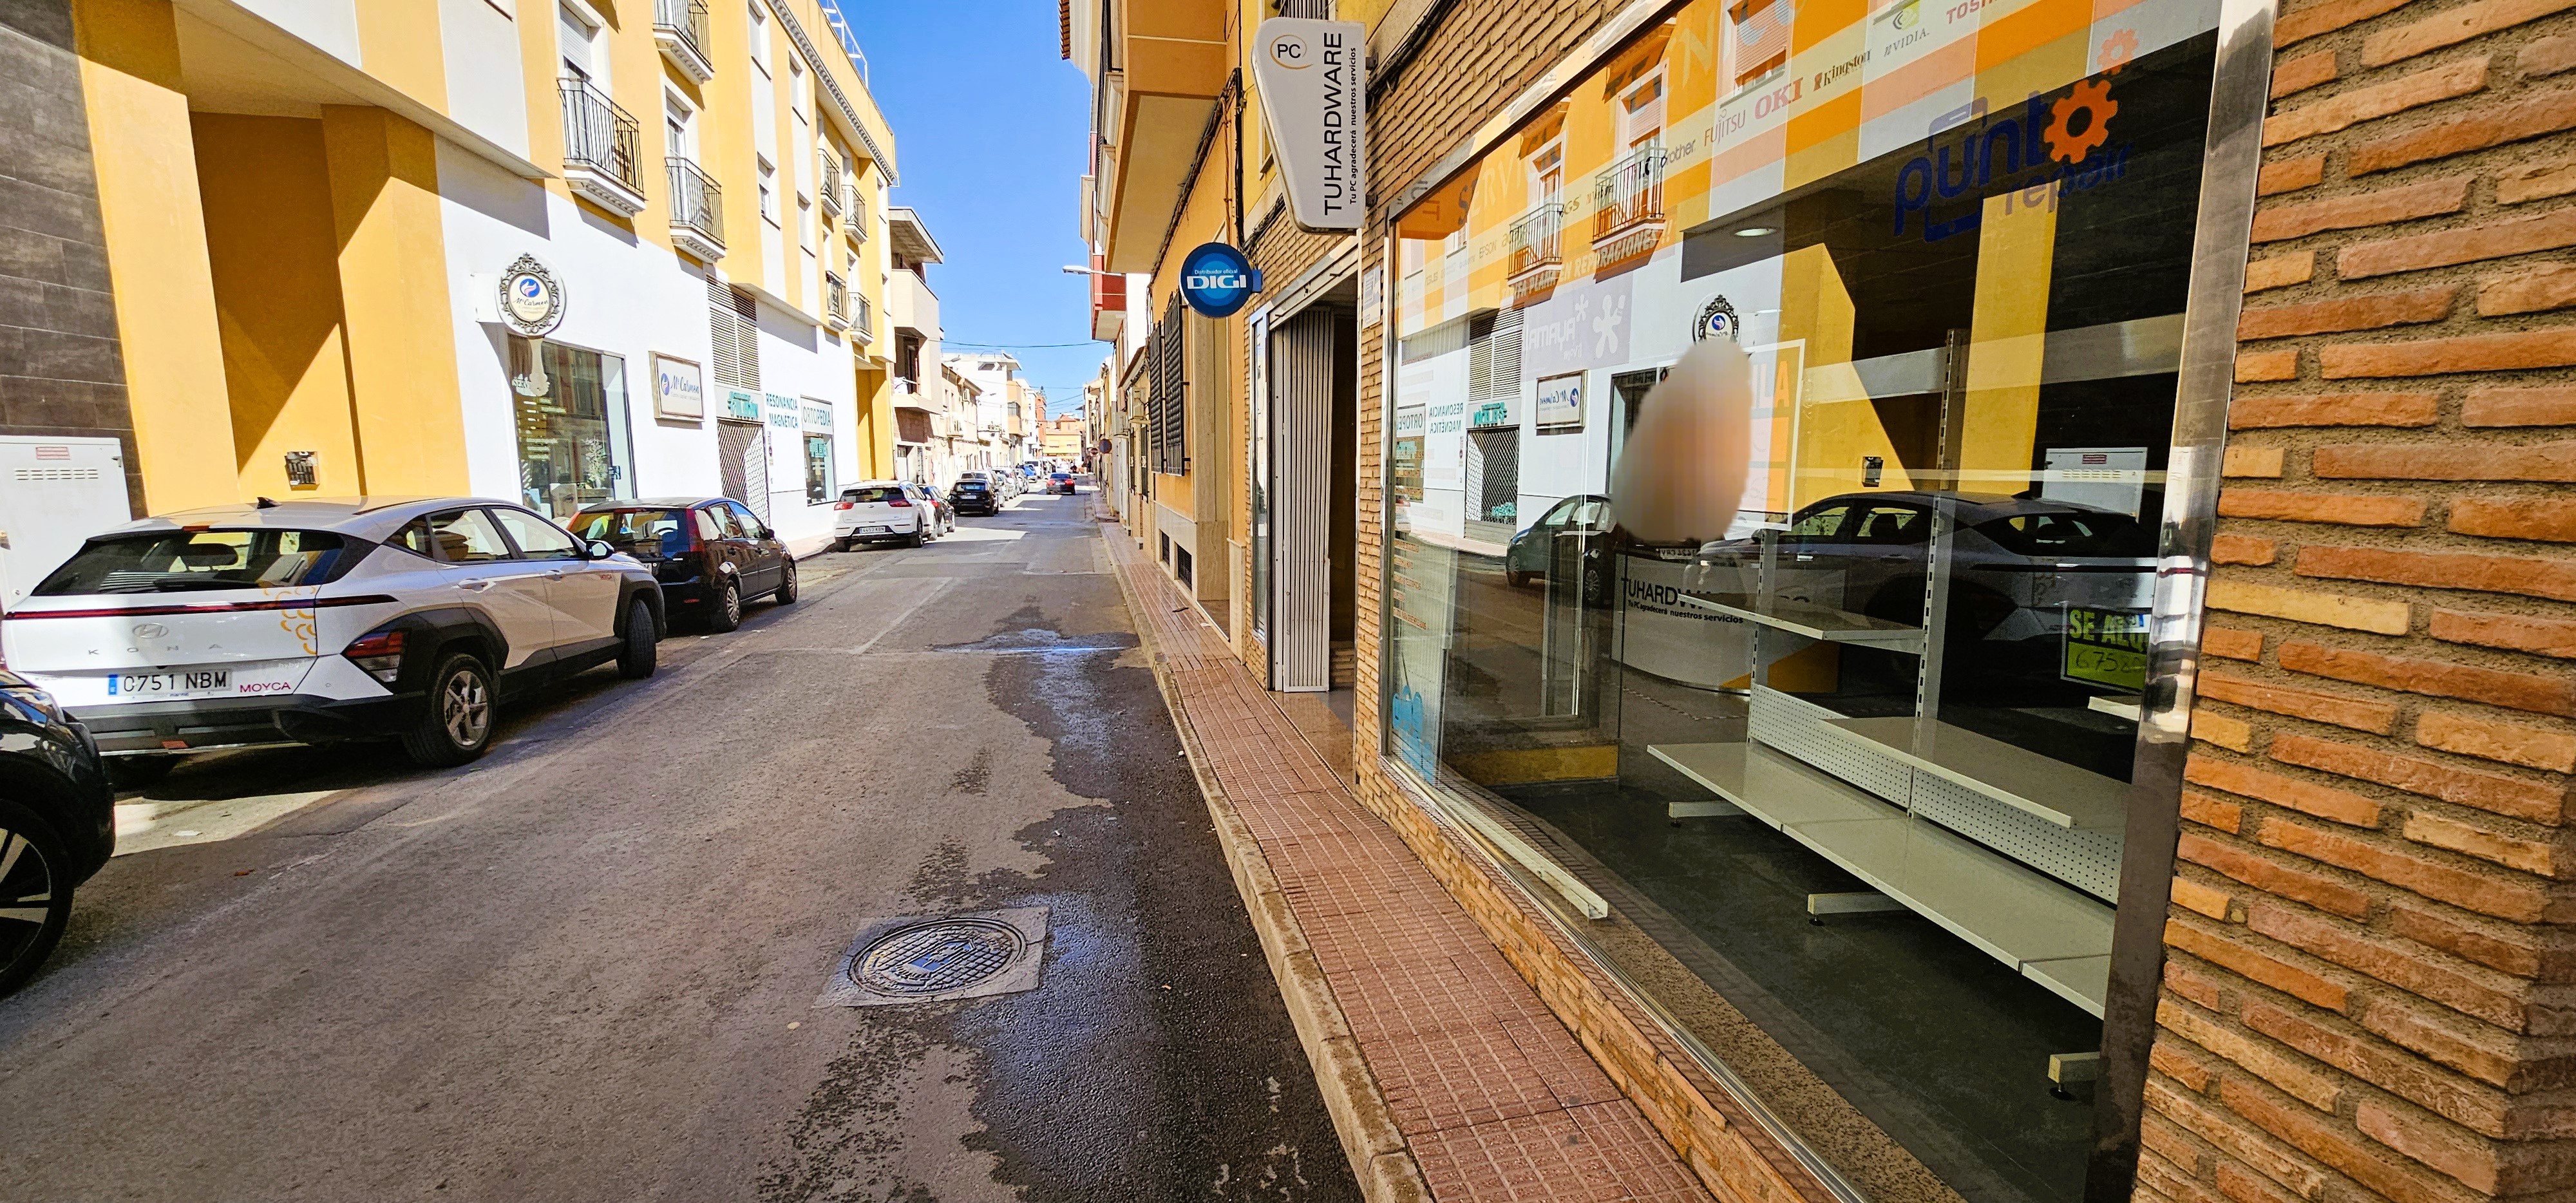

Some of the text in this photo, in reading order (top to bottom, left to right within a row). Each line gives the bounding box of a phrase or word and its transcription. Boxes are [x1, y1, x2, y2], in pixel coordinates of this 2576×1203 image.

[1277, 44, 1301, 58] PC
[1704, 109, 1746, 147] FUJITSU
[1754, 77, 1803, 120] OKI
[1823, 50, 1871, 87] Kingston
[1323, 32, 1341, 215] TUHARDWARE
[1349, 129, 1358, 179] agradecerá
[1350, 180, 1357, 191] PC
[2005, 142, 2135, 216] repair
[1350, 192, 1357, 204] Tu
[1575, 228, 1656, 278] REPARACIONES
[1187, 275, 1247, 289] DIGI
[680, 376, 699, 394] Carmen
[766, 393, 799, 410] RESONANCIA
[769, 413, 799, 428] MAGNÉTICA
[803, 406, 831, 426] ORTOPEDIA
[1670, 610, 1703, 620] nuestros
[1703, 614, 1744, 623] servicios
[2069, 609, 2095, 641] SE
[88, 643, 223, 656] KONA
[124, 672, 227, 693] 0751 NBM
[240, 682, 291, 694] MOYCA
